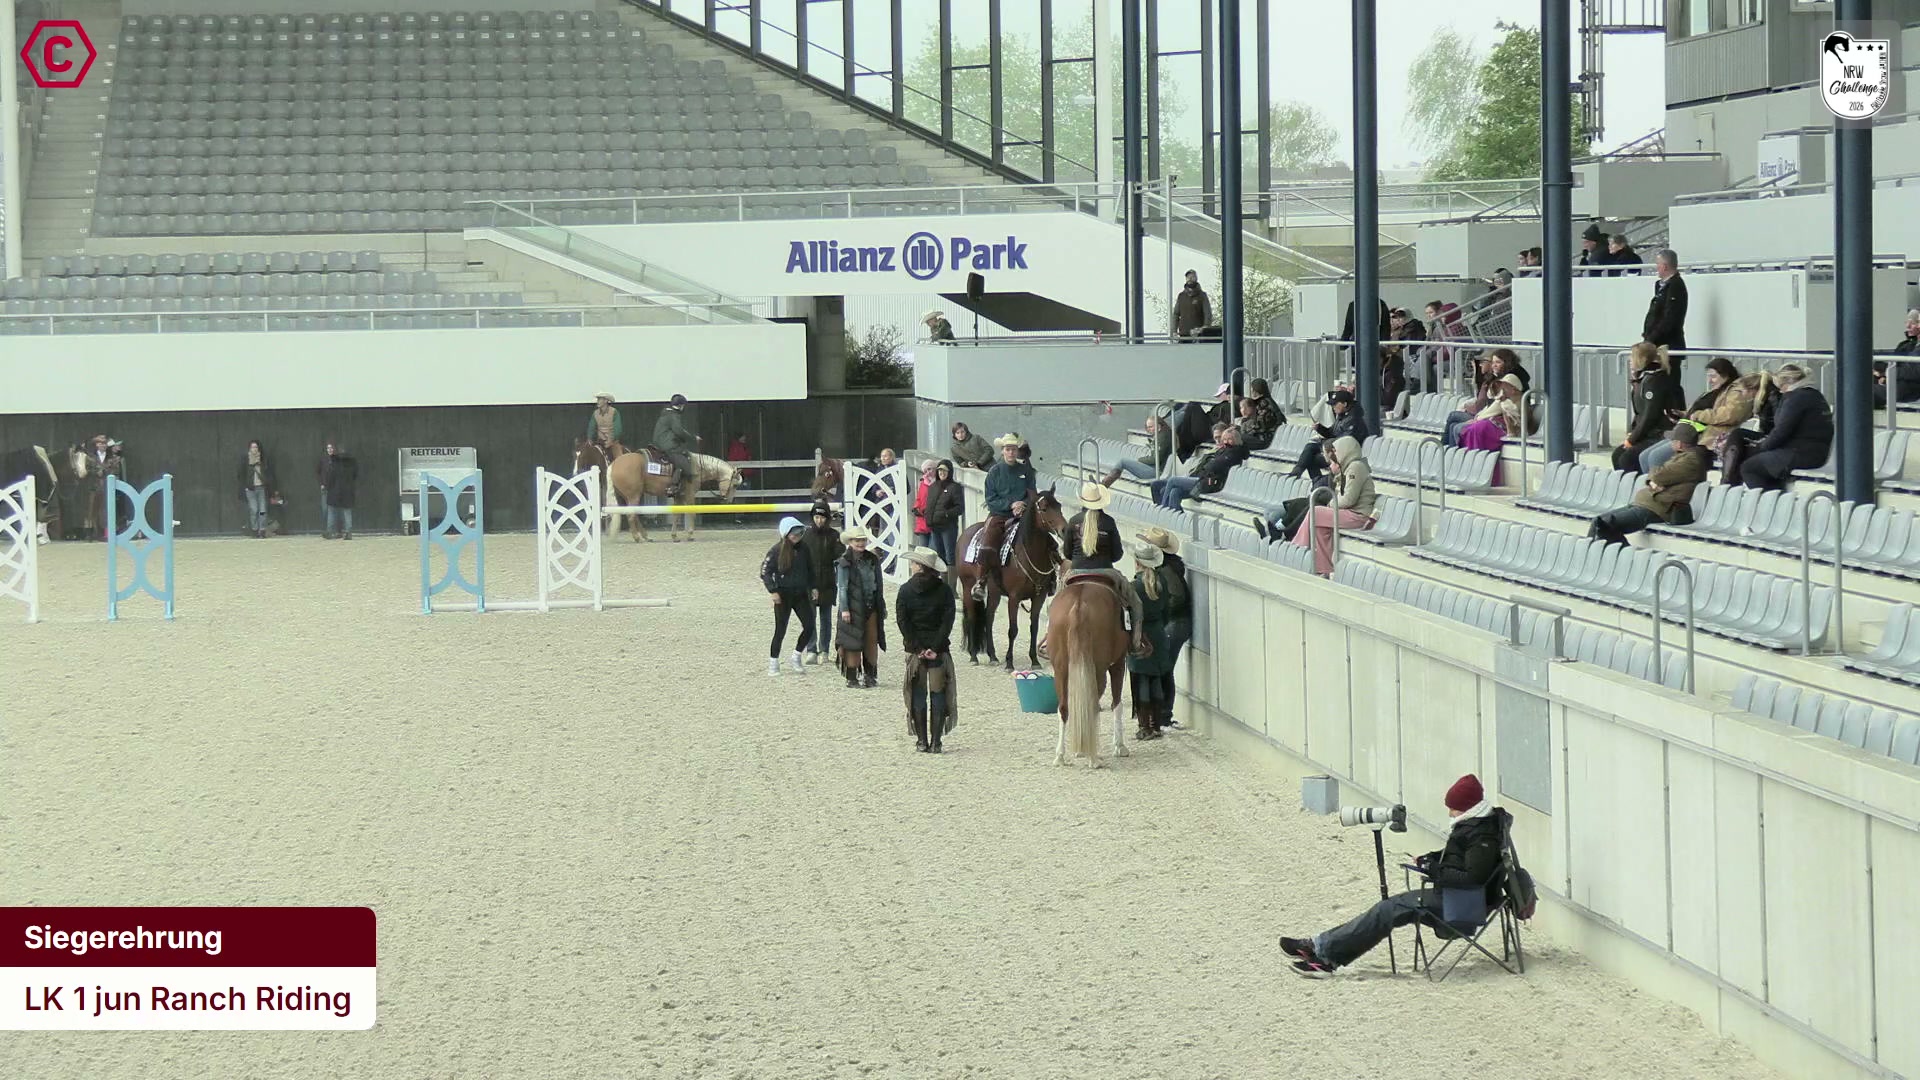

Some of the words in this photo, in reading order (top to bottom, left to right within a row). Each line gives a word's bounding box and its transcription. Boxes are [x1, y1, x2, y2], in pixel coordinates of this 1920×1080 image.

[785, 240, 896, 273] Allianz
[950, 236, 1029, 270] Park
[410, 448, 461, 456] REITERLIVE
